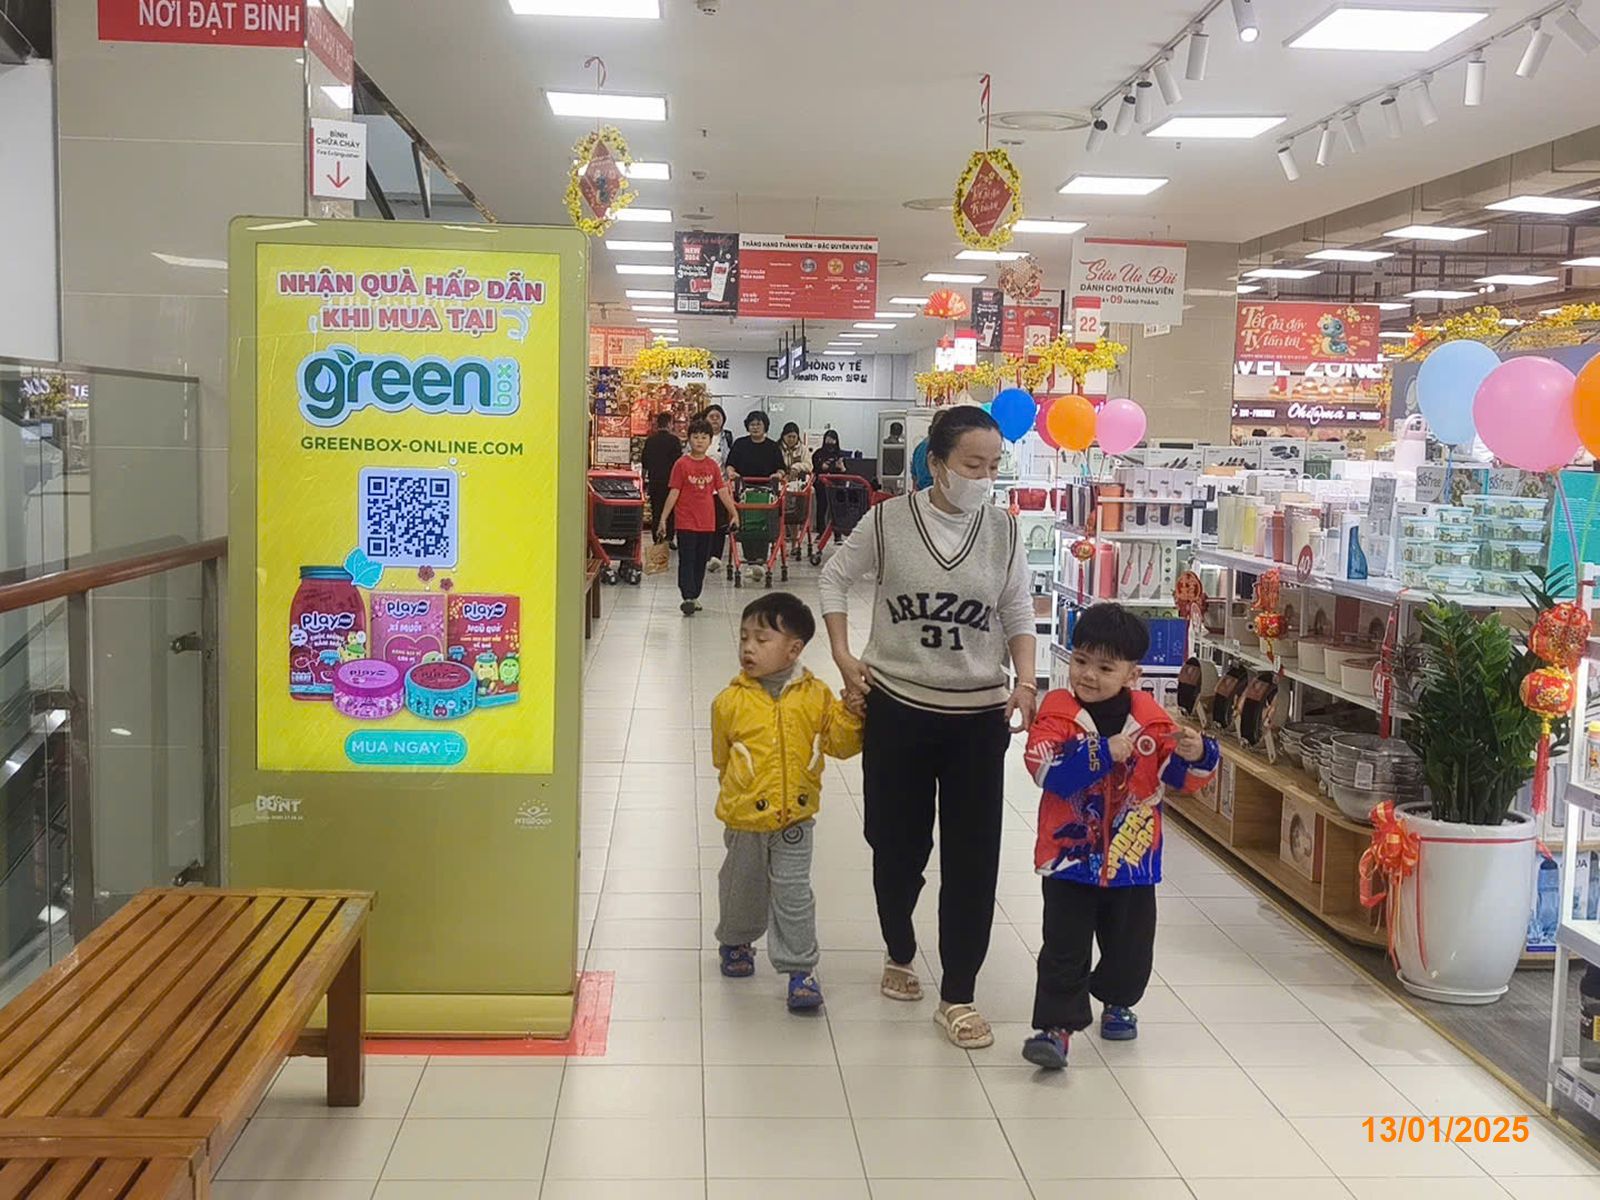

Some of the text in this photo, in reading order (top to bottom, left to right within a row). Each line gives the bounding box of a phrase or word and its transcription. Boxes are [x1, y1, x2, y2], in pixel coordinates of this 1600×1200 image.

[138, 0, 299, 35] NƠI ĐẠT BÌNH
[279, 268, 543, 302] NHẬN QUÀ HẤP DẪN
[1106, 284, 1124, 292] CHO
[1110, 295, 1123, 304] 09
[322, 307, 496, 336] KHI MUA TẠI
[1080, 316, 1097, 332] 22
[1033, 334, 1047, 347] 23
[806, 358, 862, 371] HÒNG Y TẾ
[304, 350, 491, 418] green
[821, 373, 843, 382] Room
[300, 436, 524, 456] GREENBOX-ONLINE.COM
[921, 624, 964, 651] 31
[352, 740, 441, 755] MUA NGAY
